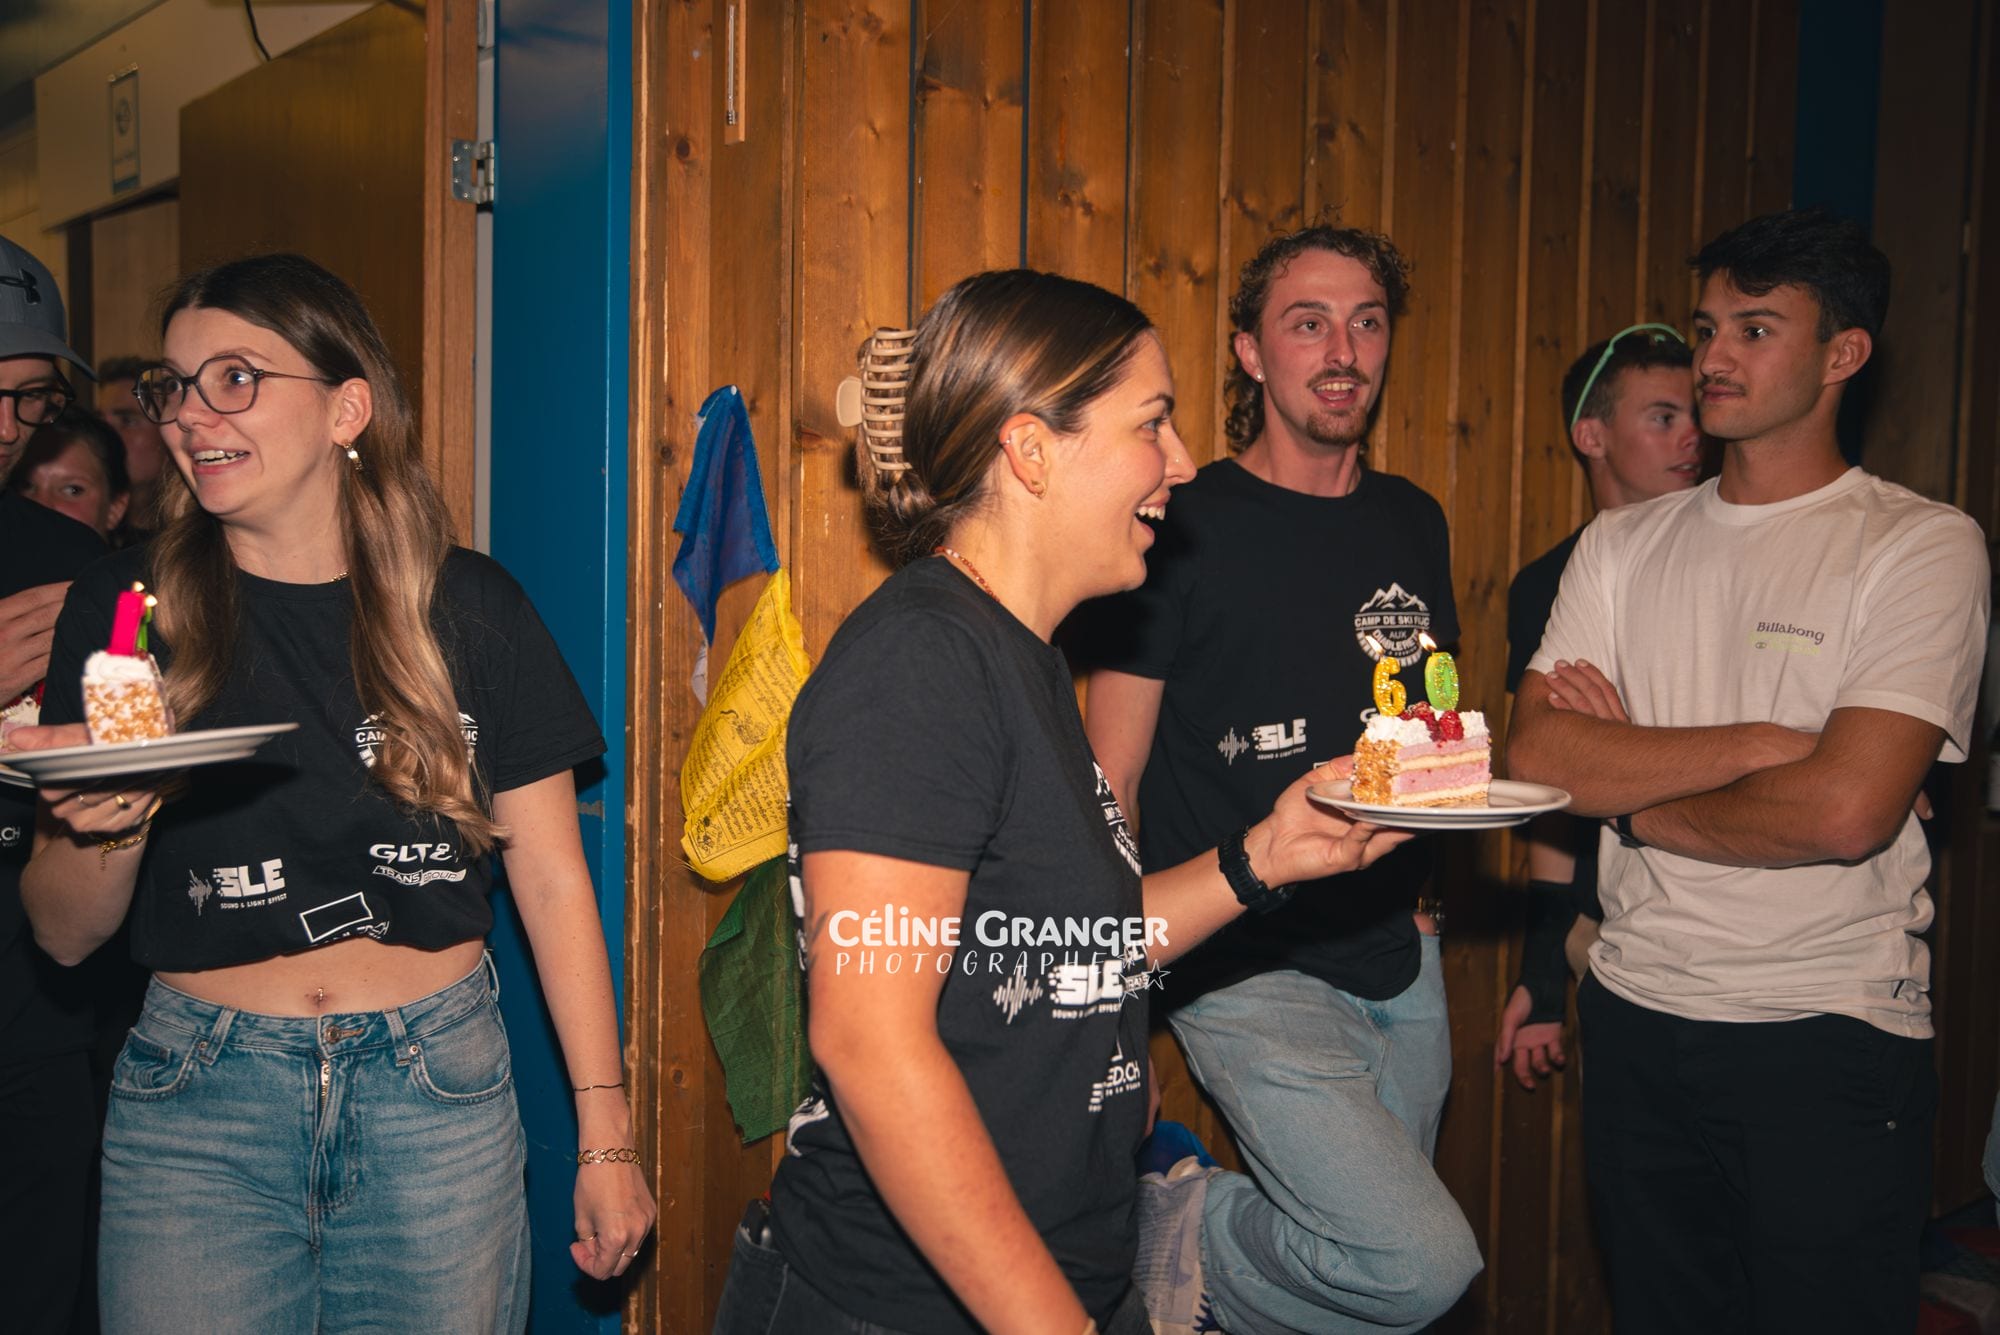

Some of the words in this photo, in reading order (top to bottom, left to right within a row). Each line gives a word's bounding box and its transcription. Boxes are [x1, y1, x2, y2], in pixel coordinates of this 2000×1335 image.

[1354, 617, 1381, 627] CAMP
[1383, 615, 1396, 625] DE
[1397, 615, 1413, 625] SKI
[1389, 630, 1407, 640] AUX
[1756, 621, 1825, 645] Billabong
[1252, 718, 1307, 751] SLE
[213, 858, 286, 897] SLE
[220, 901, 240, 909] SOUND
[246, 899, 266, 908] LIGHT
[267, 892, 288, 905] EFFECT
